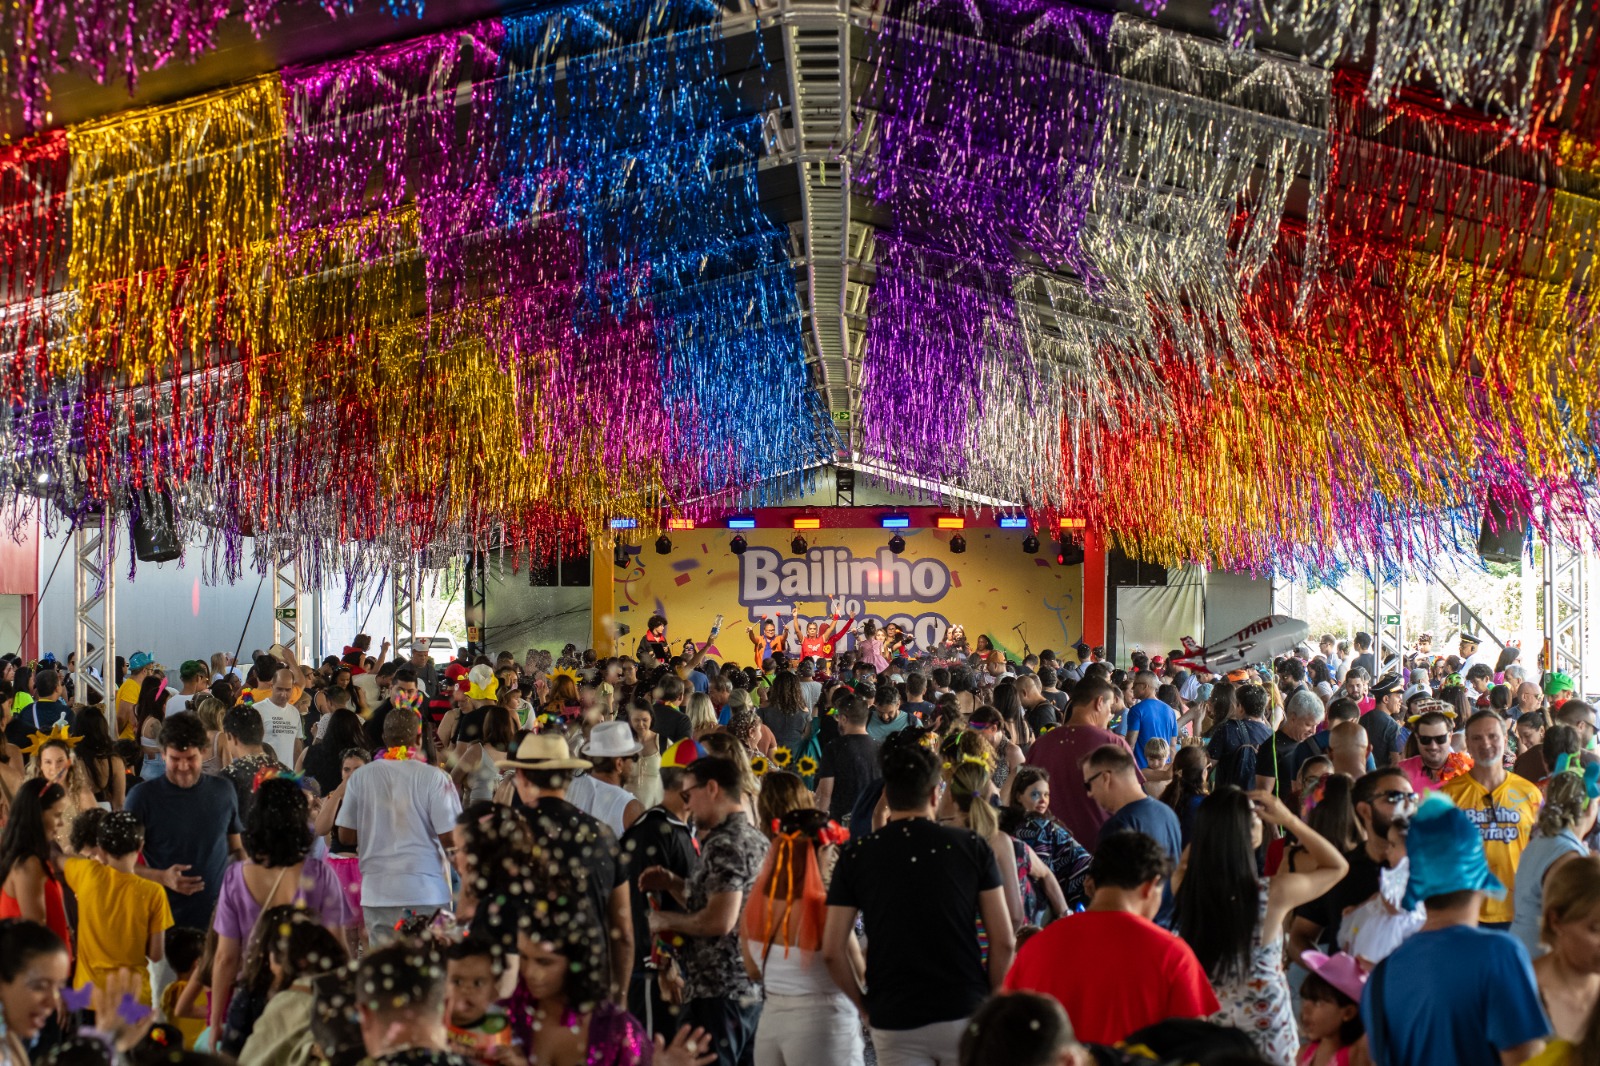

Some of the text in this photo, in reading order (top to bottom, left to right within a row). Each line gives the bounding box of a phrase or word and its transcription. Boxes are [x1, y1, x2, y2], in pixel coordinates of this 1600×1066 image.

[743, 549, 946, 600] Bailinho
[830, 594, 861, 617] do
[1237, 615, 1273, 642] TAM
[1466, 808, 1520, 823] Bainho
[1473, 824, 1518, 843] erraço
